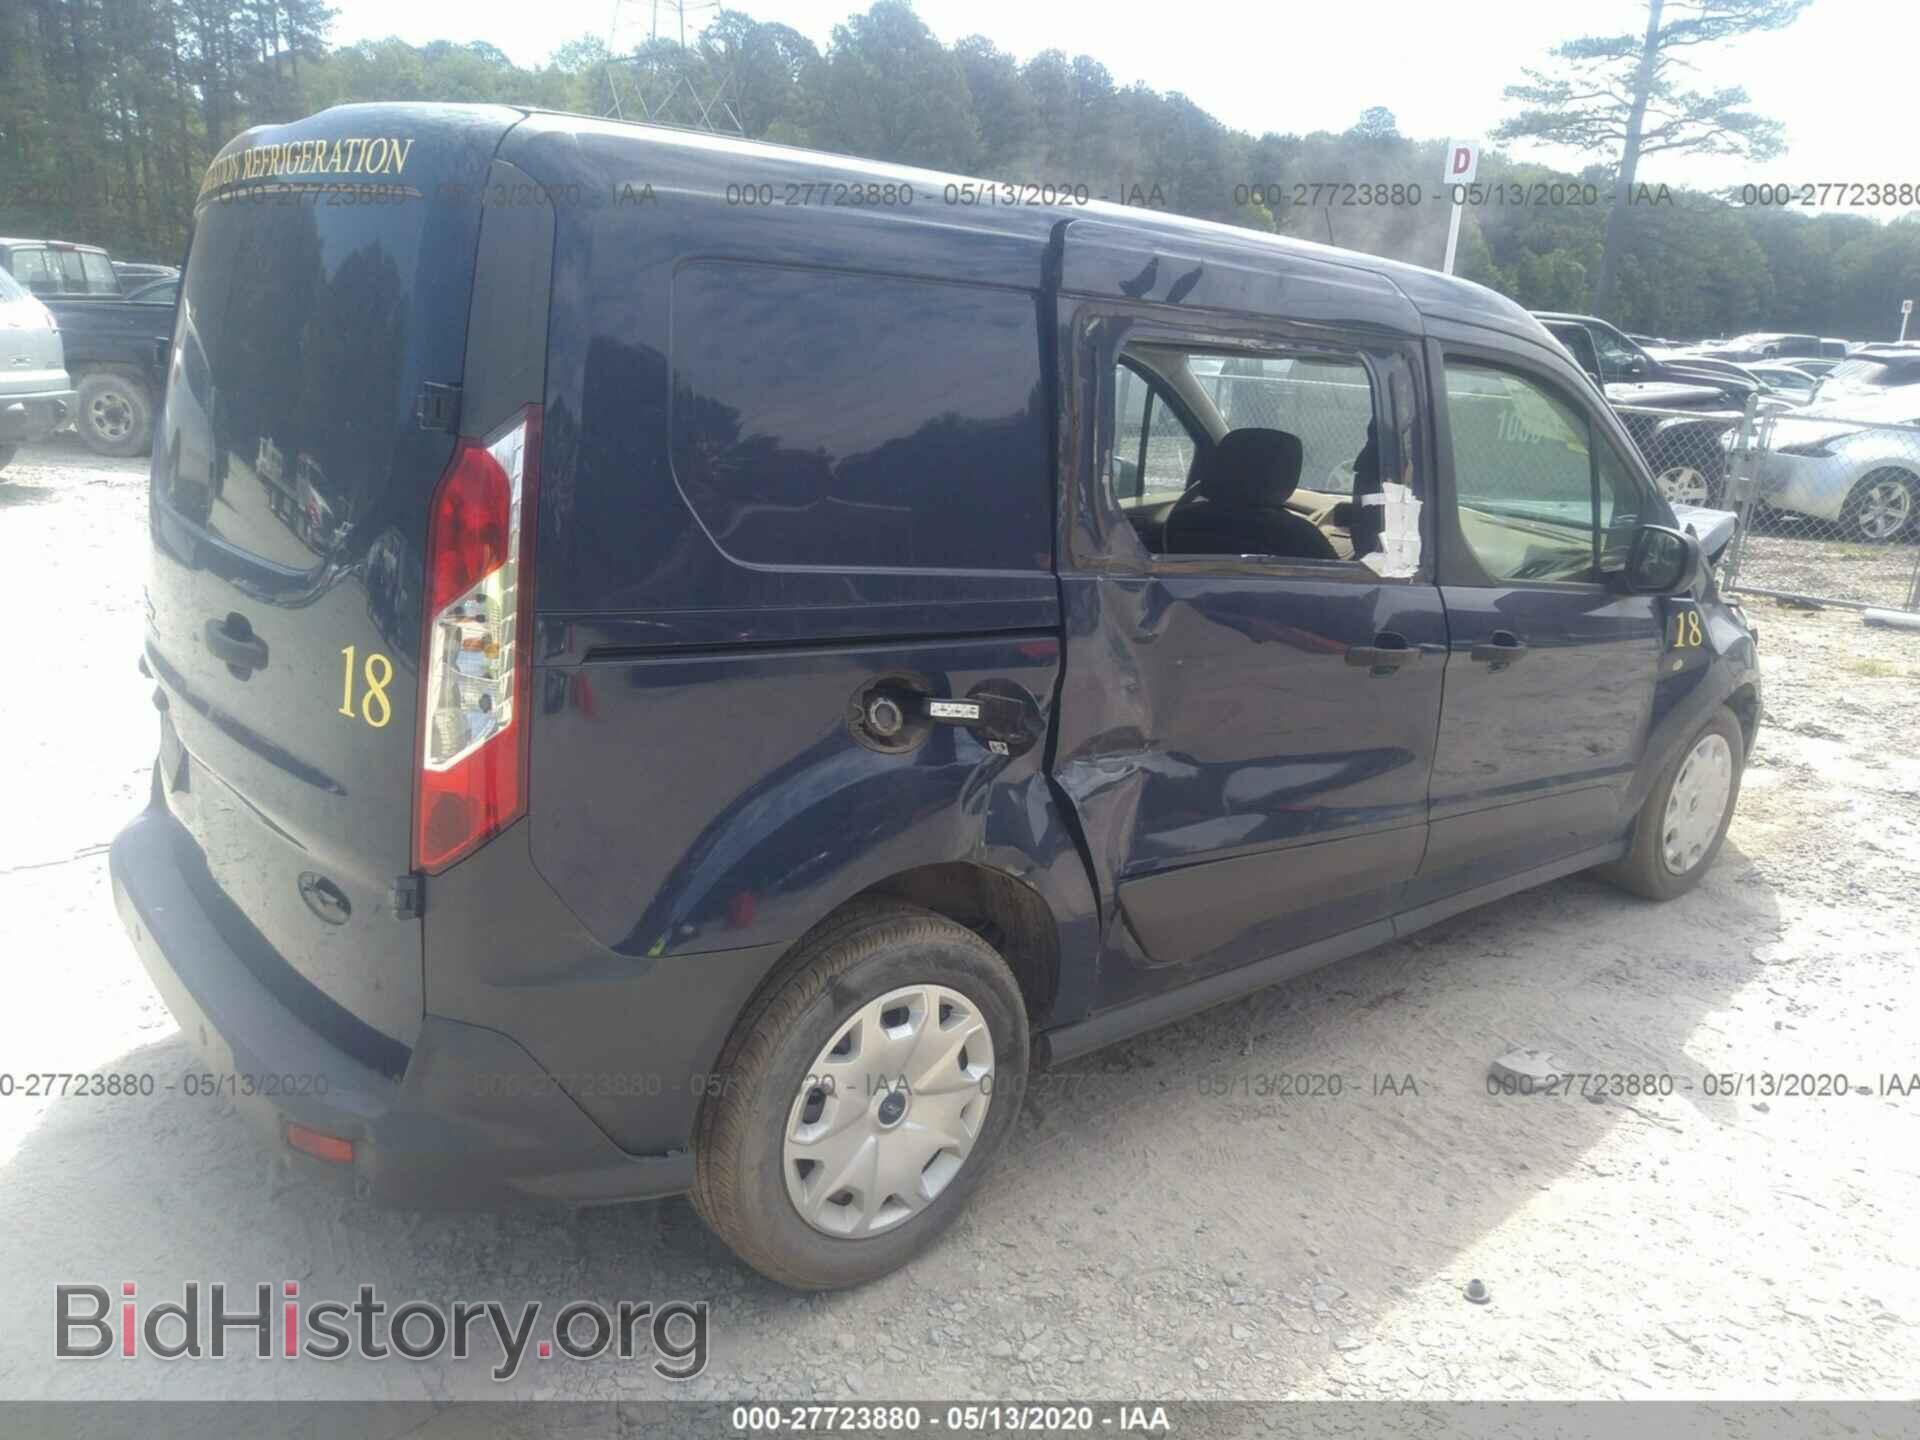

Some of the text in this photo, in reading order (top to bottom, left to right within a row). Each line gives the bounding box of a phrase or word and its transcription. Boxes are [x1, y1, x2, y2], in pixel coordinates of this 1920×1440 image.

[241, 137, 416, 181] REFRIGERATION
[1453, 148, 1471, 175] D
[1673, 610, 1703, 648] 18
[338, 645, 393, 728] 18
